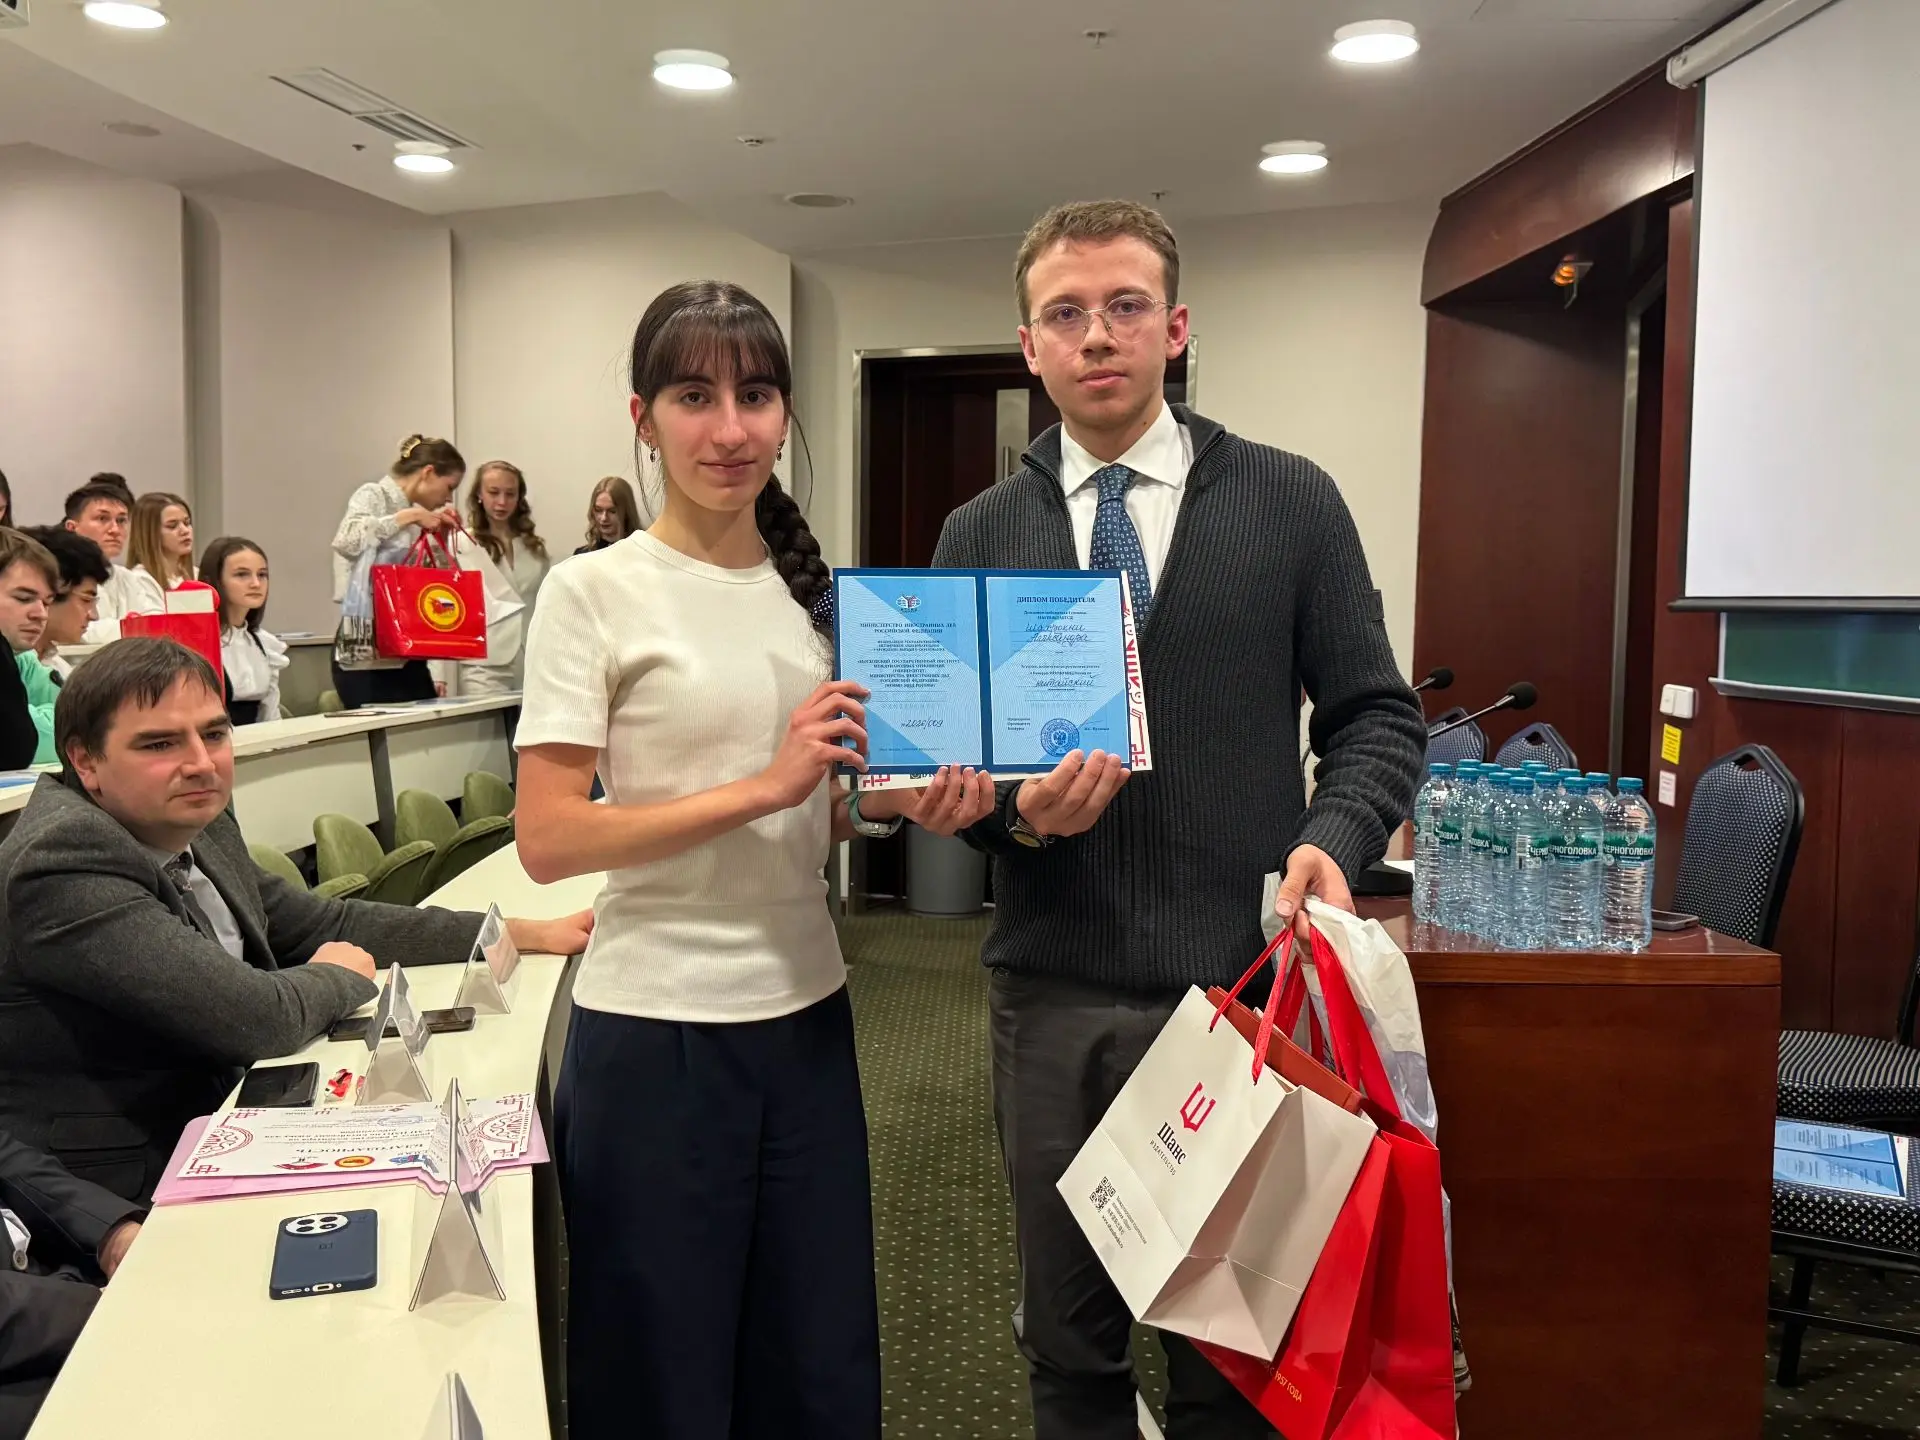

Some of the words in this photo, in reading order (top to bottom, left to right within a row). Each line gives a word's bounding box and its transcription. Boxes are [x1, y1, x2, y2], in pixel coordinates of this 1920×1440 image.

[1548, 844, 1597, 856] ЕРНОГОЛОВКА
[1150, 1139, 1176, 1176] ИЗДАТЕЛЬСТВО
[1157, 1122, 1187, 1165] Шанс
[1275, 1370, 1288, 1387] 1957
[1287, 1382, 1302, 1403] ГОДА
